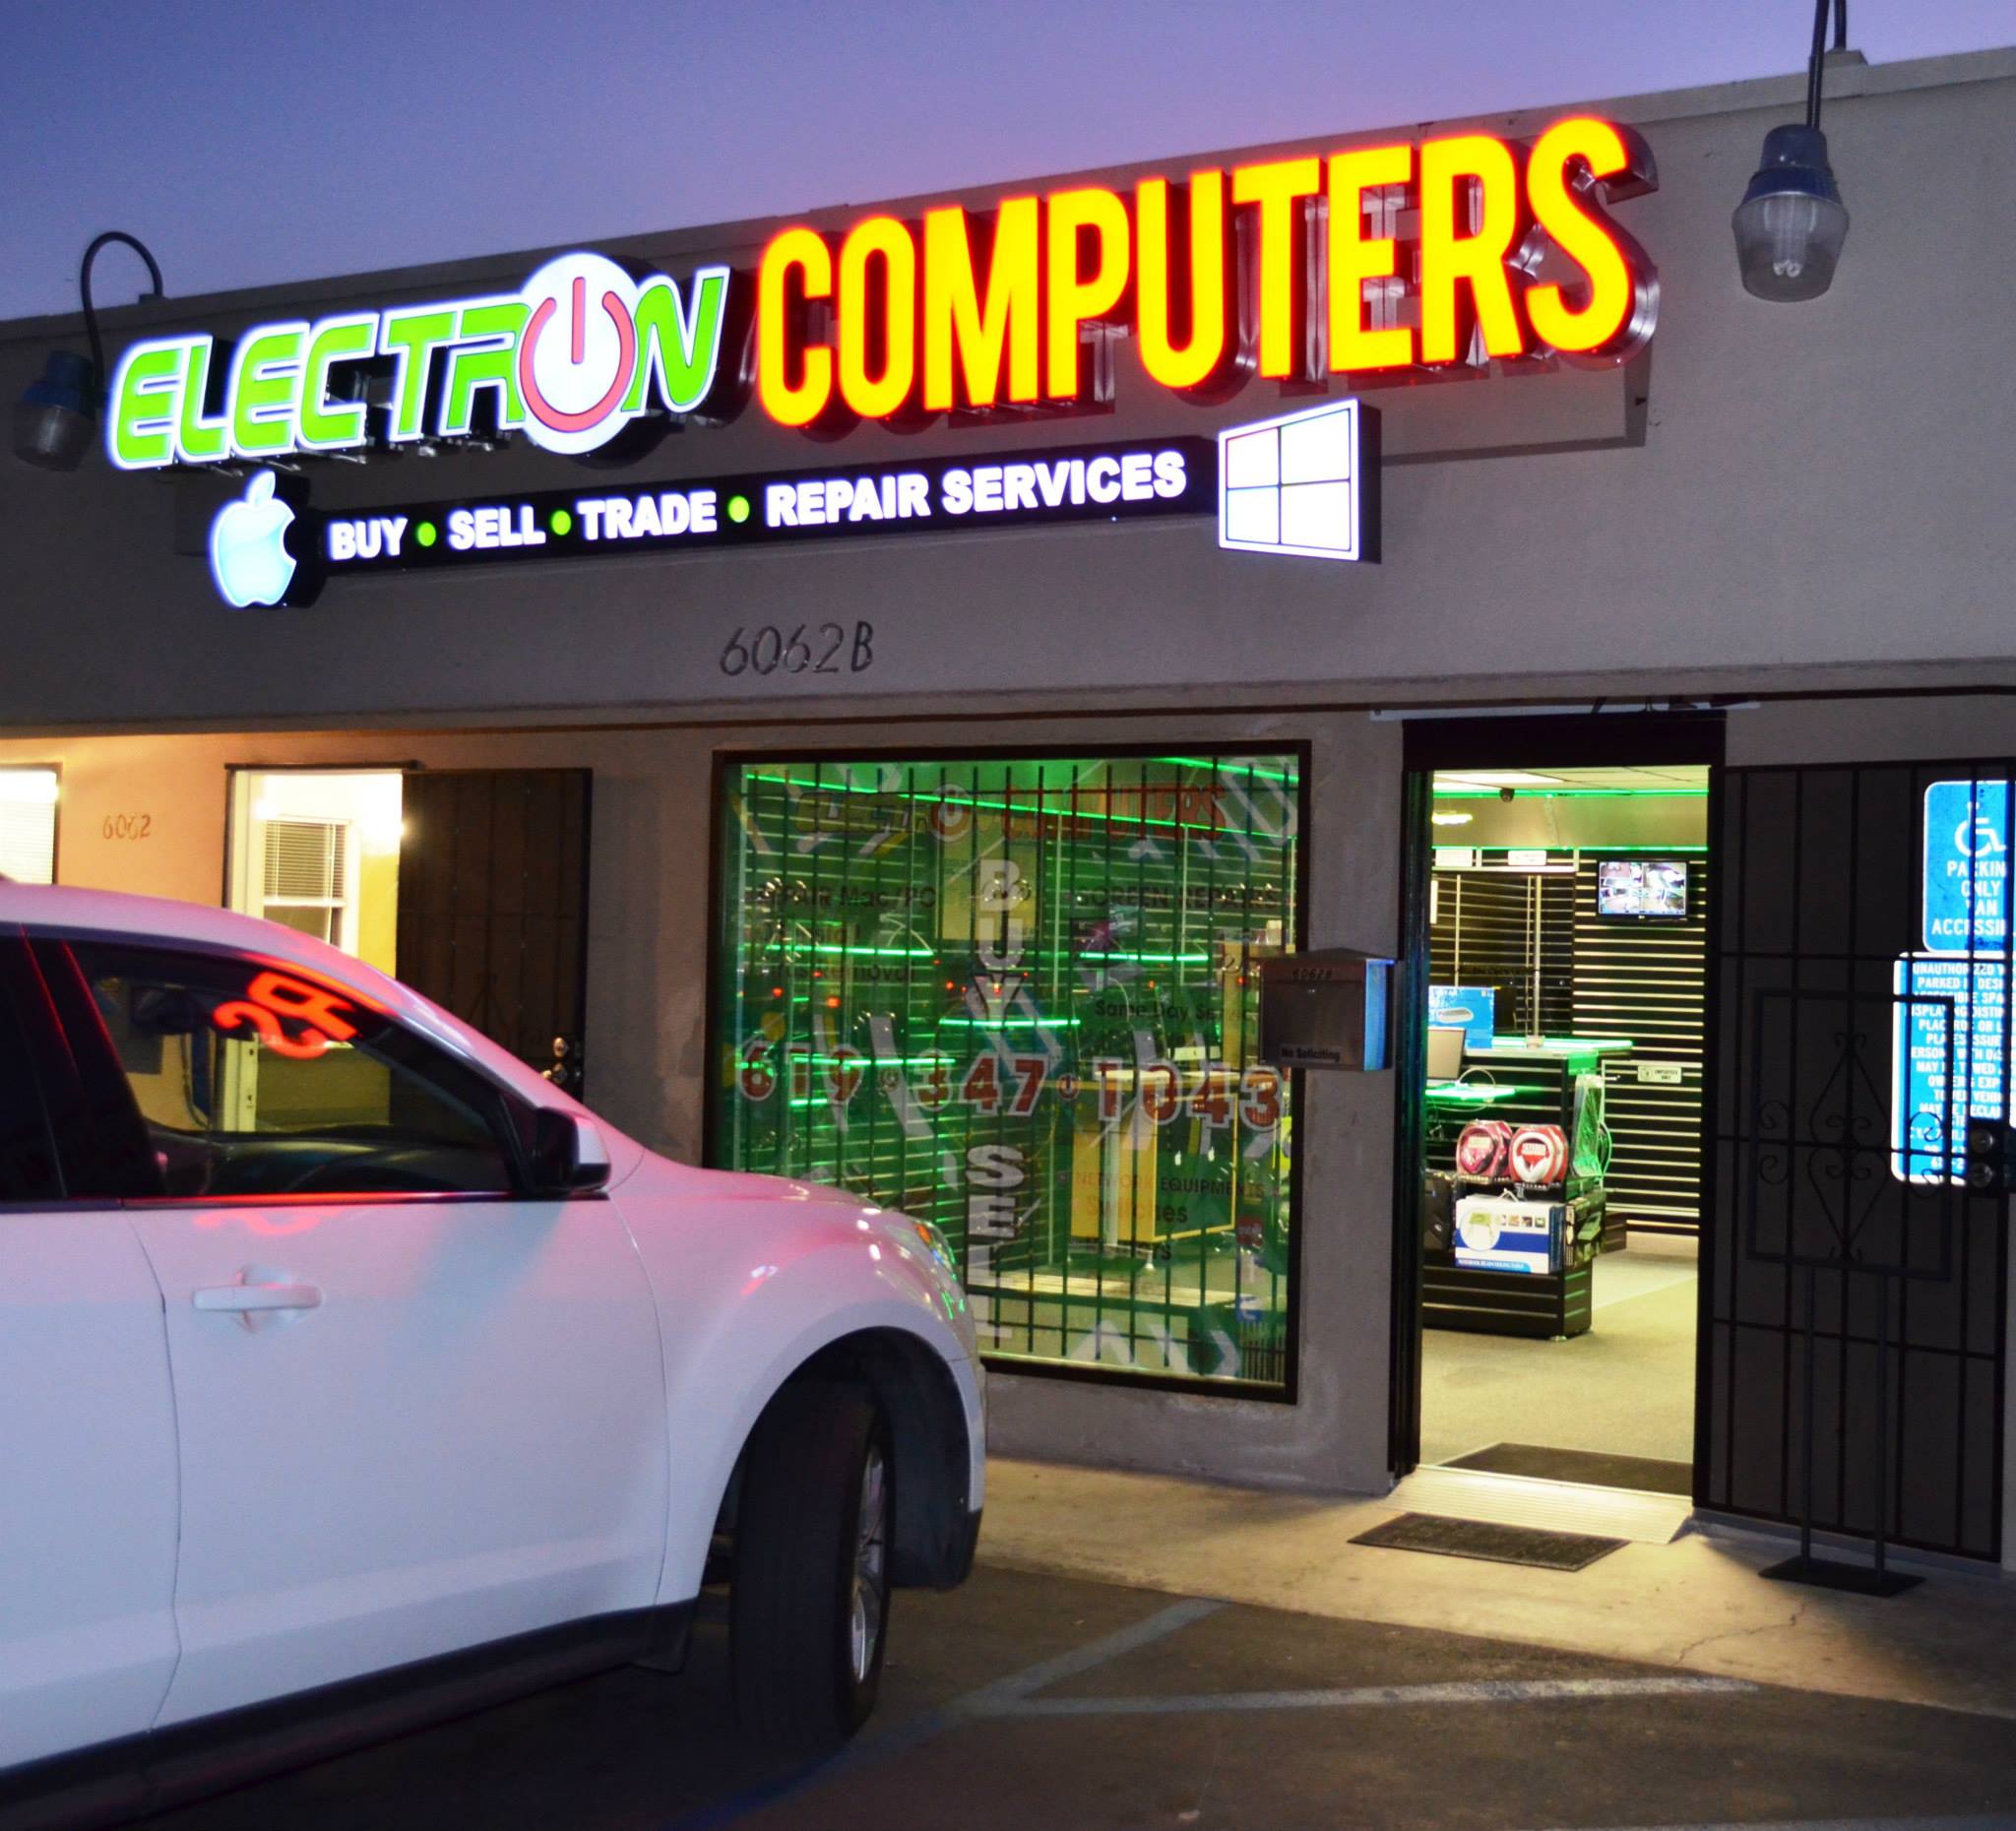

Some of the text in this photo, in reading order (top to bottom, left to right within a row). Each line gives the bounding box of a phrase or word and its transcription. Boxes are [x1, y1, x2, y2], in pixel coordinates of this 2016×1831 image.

[108, 115, 1632, 472] ELECTRON COMPUTERS
[330, 450, 1188, 561] BUY SELL TRADE REPAIR SERVICES
[720, 621, 874, 676] 6062B
[101, 813, 153, 840] 6062
[1960, 879, 2001, 898] ONLY
[972, 858, 1030, 1034] BUY
[739, 1039, 1286, 1133] 619 347 1043
[965, 1144, 1025, 1339] SELL
